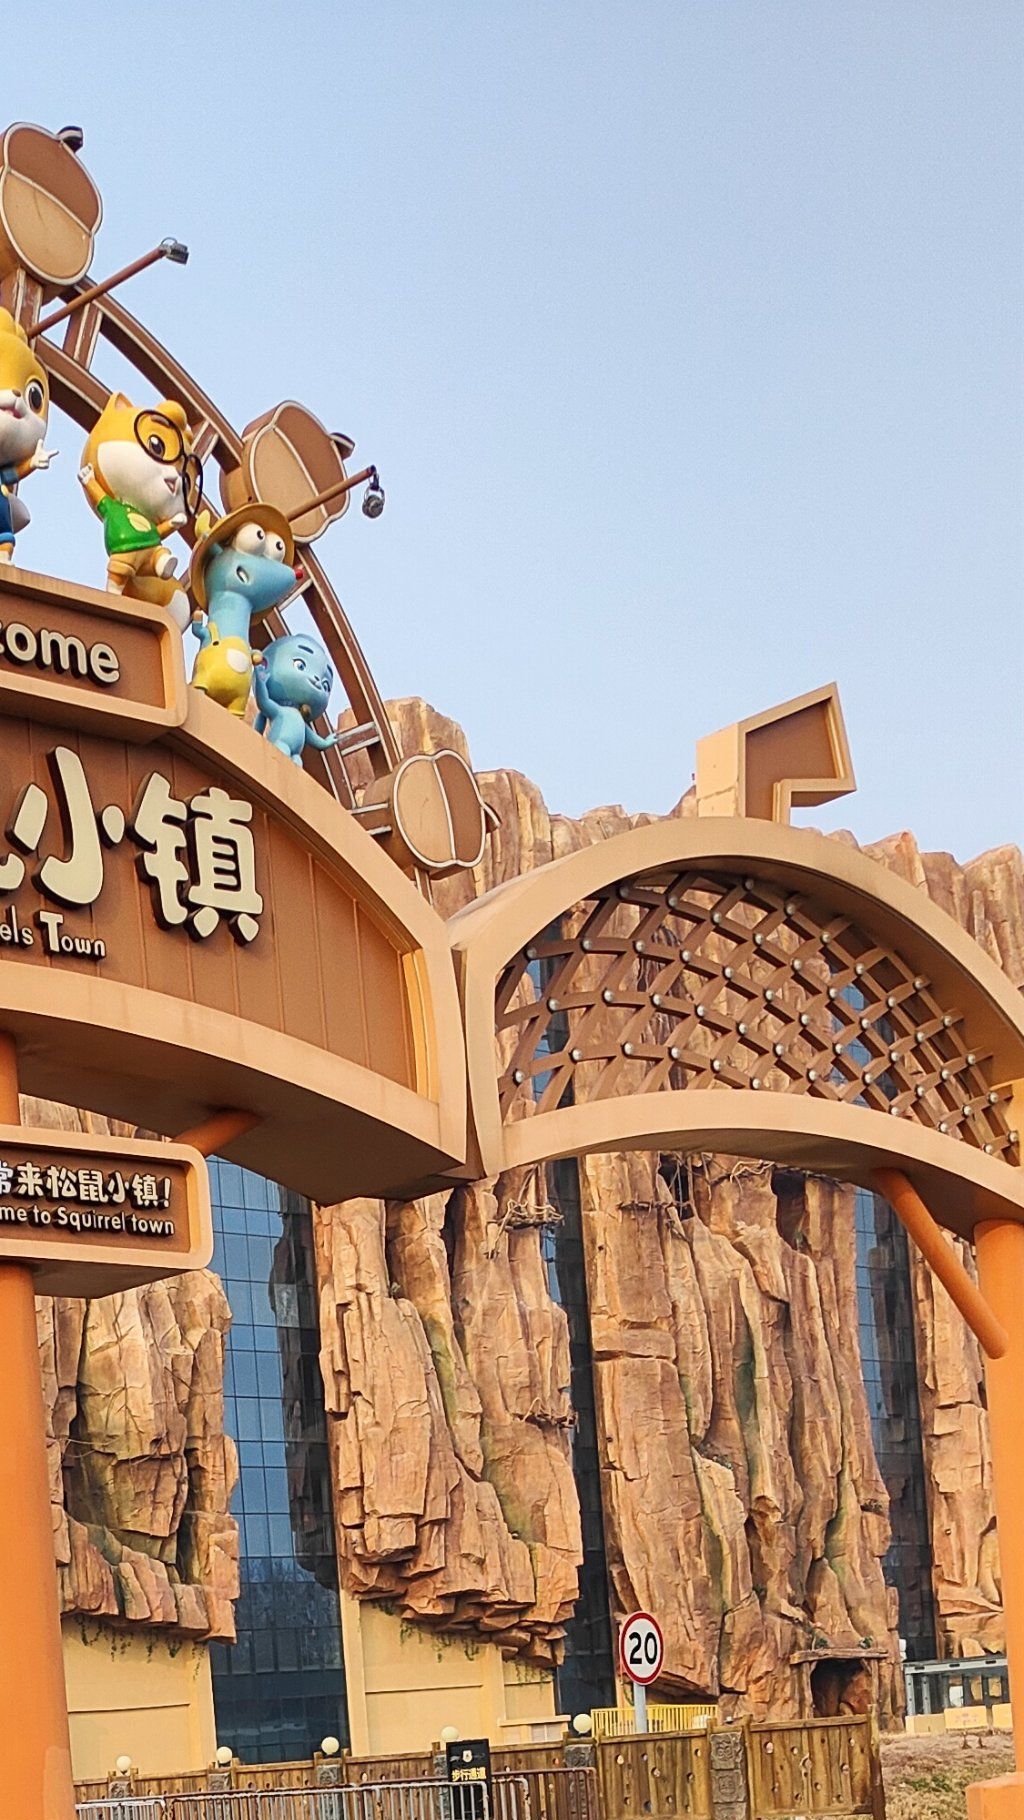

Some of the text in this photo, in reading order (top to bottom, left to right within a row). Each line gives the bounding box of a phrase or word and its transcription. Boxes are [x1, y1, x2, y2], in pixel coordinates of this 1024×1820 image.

[39, 911, 106, 957] Town
[32, 1205, 51, 1224] to
[57, 1206, 126, 1231] Squirrel
[131, 1214, 174, 1234] town
[629, 1632, 658, 1665] 20
[451, 1766, 487, 1782] 步行通道
